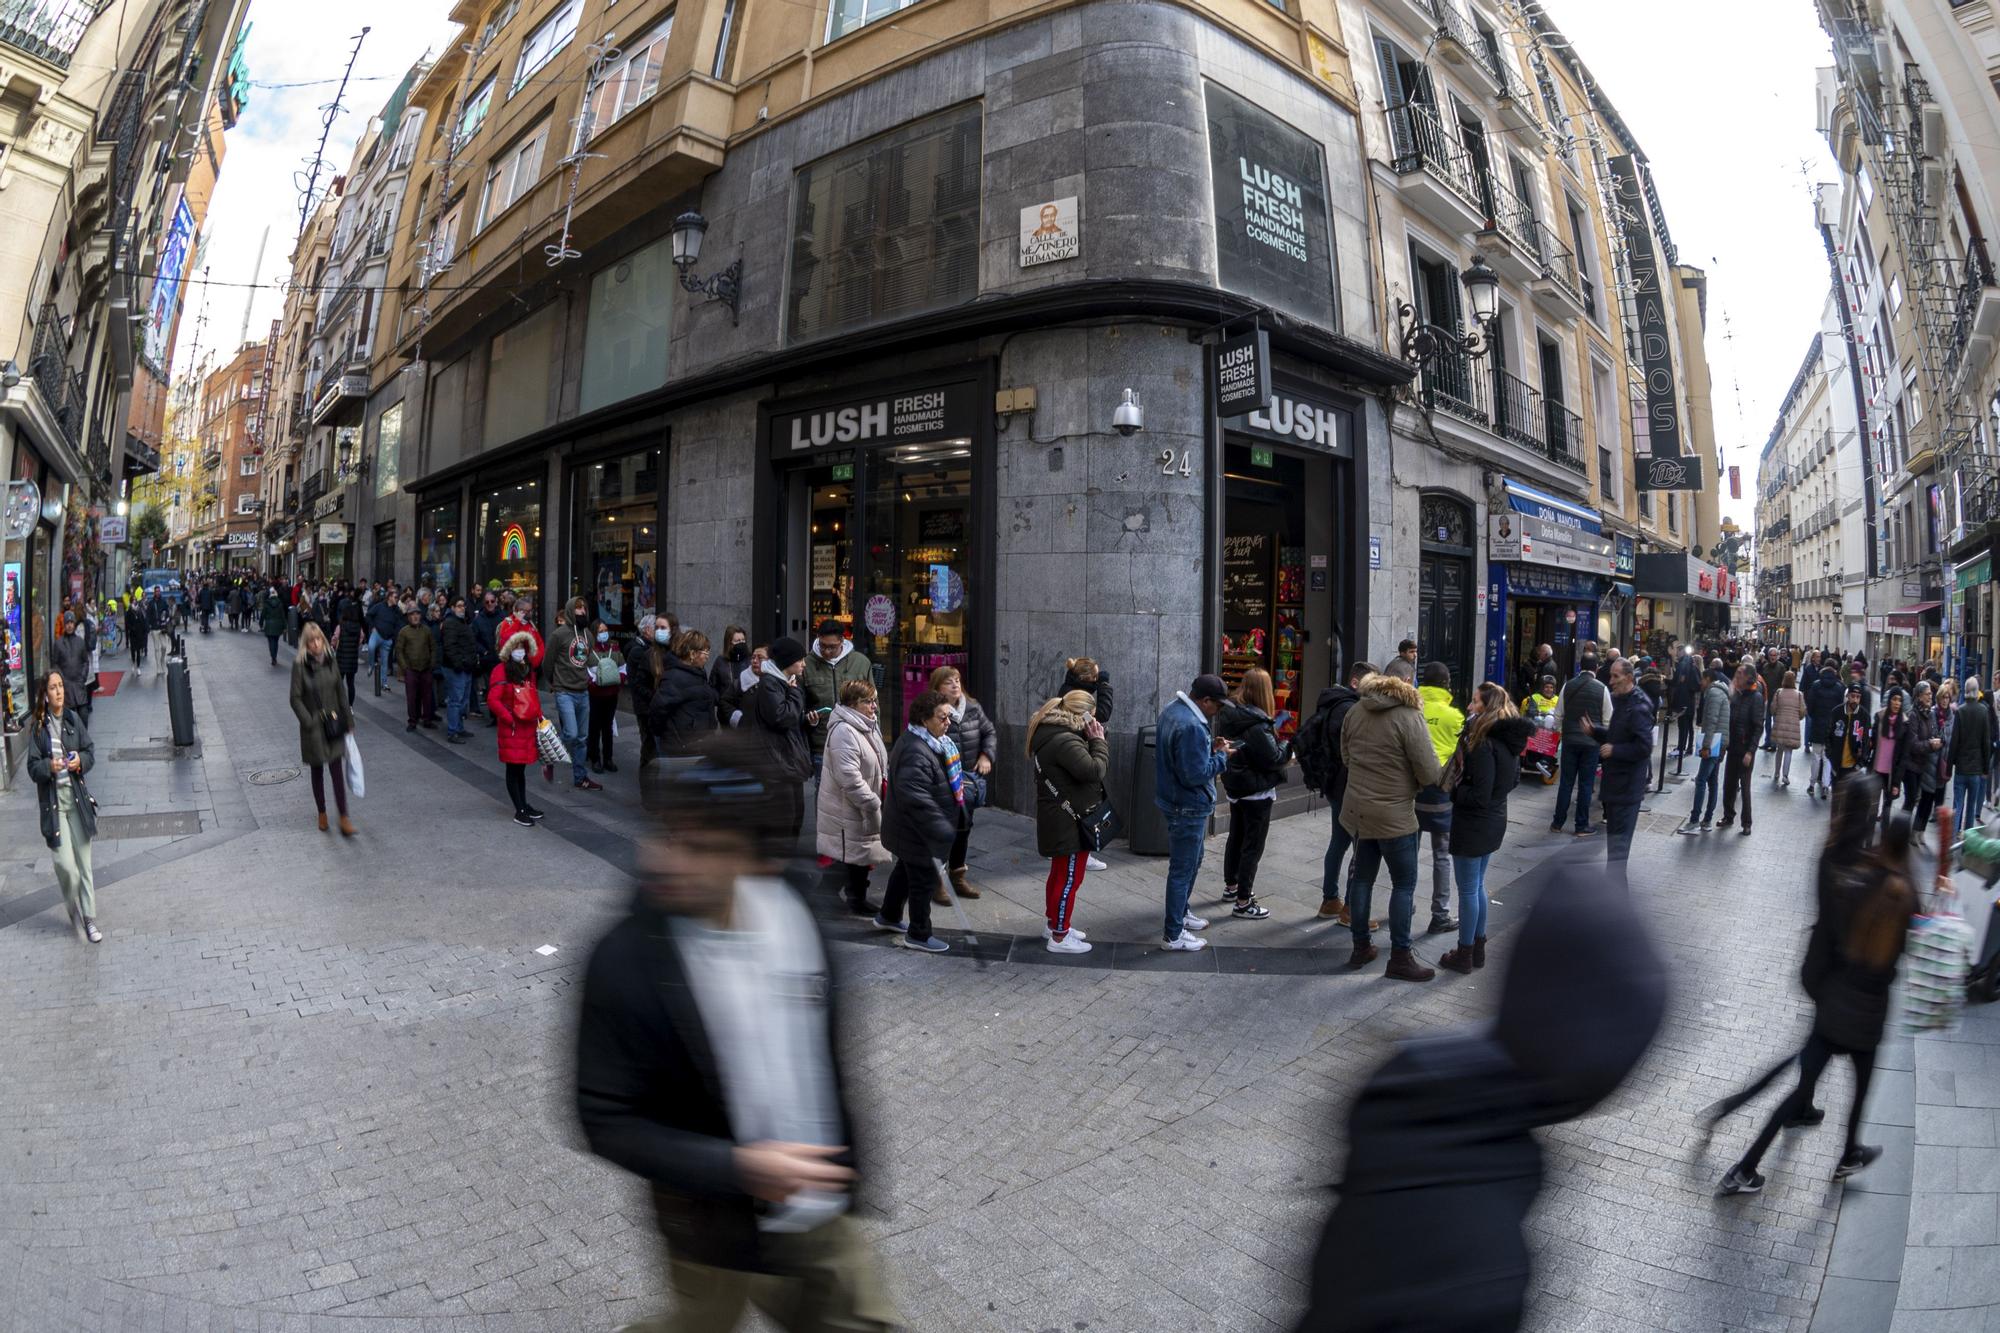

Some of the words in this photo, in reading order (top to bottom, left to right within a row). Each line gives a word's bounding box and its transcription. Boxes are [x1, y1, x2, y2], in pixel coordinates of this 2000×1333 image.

[1240, 157, 1301, 208] LUSH
[1242, 184, 1304, 232] FRESH
[1030, 232, 1055, 244] CALLE
[1244, 207, 1305, 247] HANDMADE
[1021, 237, 1077, 255] MESONERO
[1246, 224, 1306, 262] COSMETICS
[1025, 247, 1073, 265] ROMANOS
[1619, 175, 1675, 432] CALZADOS
[1219, 345, 1253, 370] LUSH
[1220, 362, 1254, 384] FRESH
[1221, 377, 1255, 393] HANDMADE
[1221, 387, 1256, 403] COSMETICS
[792, 402, 888, 450] LUSH
[894, 391, 945, 414] FRESH
[894, 408, 945, 425] HANDMADE
[894, 420, 944, 436] COSMETICS
[1249, 395, 1337, 448] LUSH
[1163, 449, 1191, 477] 24
[1539, 506, 1555, 521] DOÑA
[1557, 513, 1582, 529] MANOLITA
[228, 531, 258, 544] EXCHANGE
